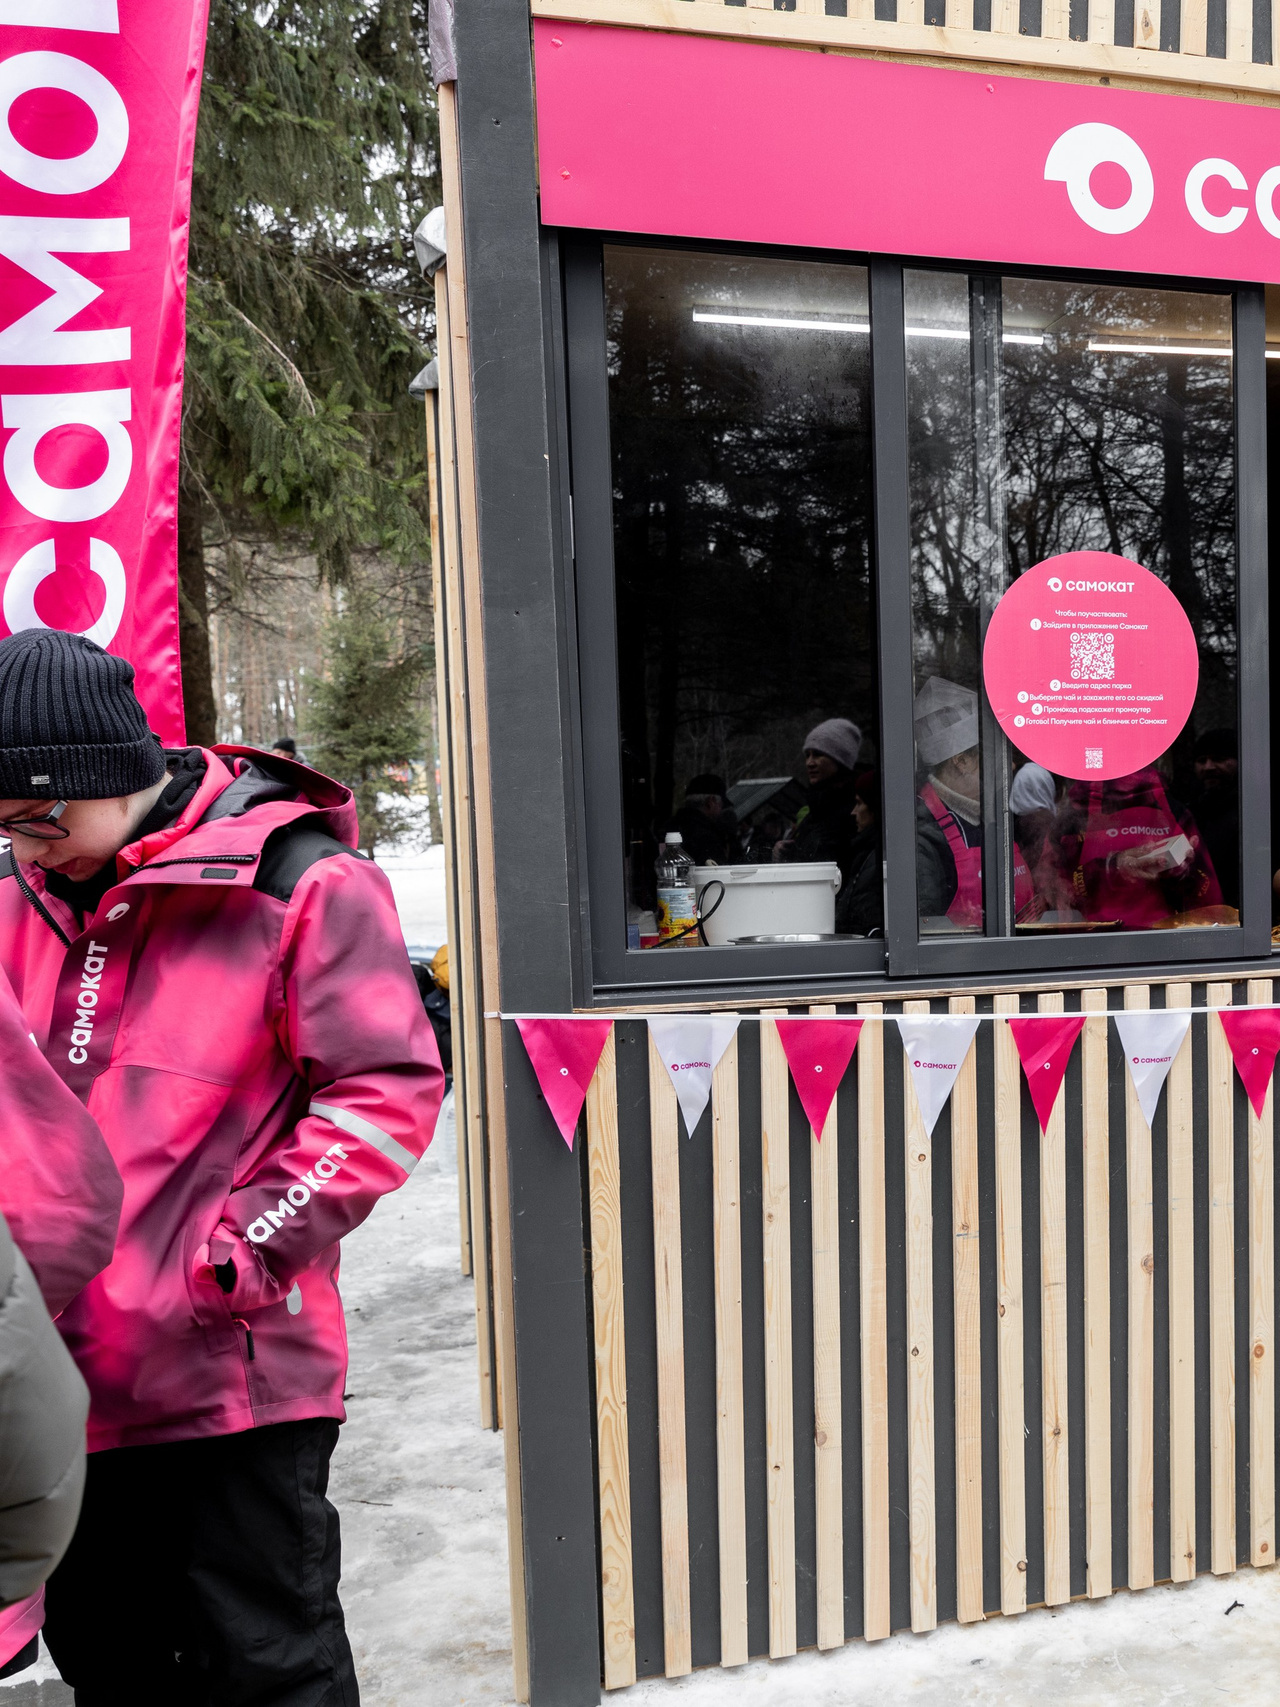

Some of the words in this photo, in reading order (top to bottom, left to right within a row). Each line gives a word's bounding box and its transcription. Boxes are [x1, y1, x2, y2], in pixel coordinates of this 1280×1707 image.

[0, 0, 132, 649] само
[1065, 580, 1135, 593] самокат
[1043, 621, 1071, 630] Зайдите
[1119, 622, 1148, 630] Самокат
[1029, 693, 1063, 702] Выберите
[1063, 693, 1076, 701] чай
[1136, 693, 1164, 702] скидкой
[1043, 705, 1078, 714] Промокод
[1026, 717, 1049, 725] Готово!
[1050, 717, 1082, 726] Получите
[1120, 825, 1170, 836] самокат
[68, 940, 108, 1064] самокат
[680, 1061, 711, 1070] самокат
[243, 1142, 349, 1244] амокат
